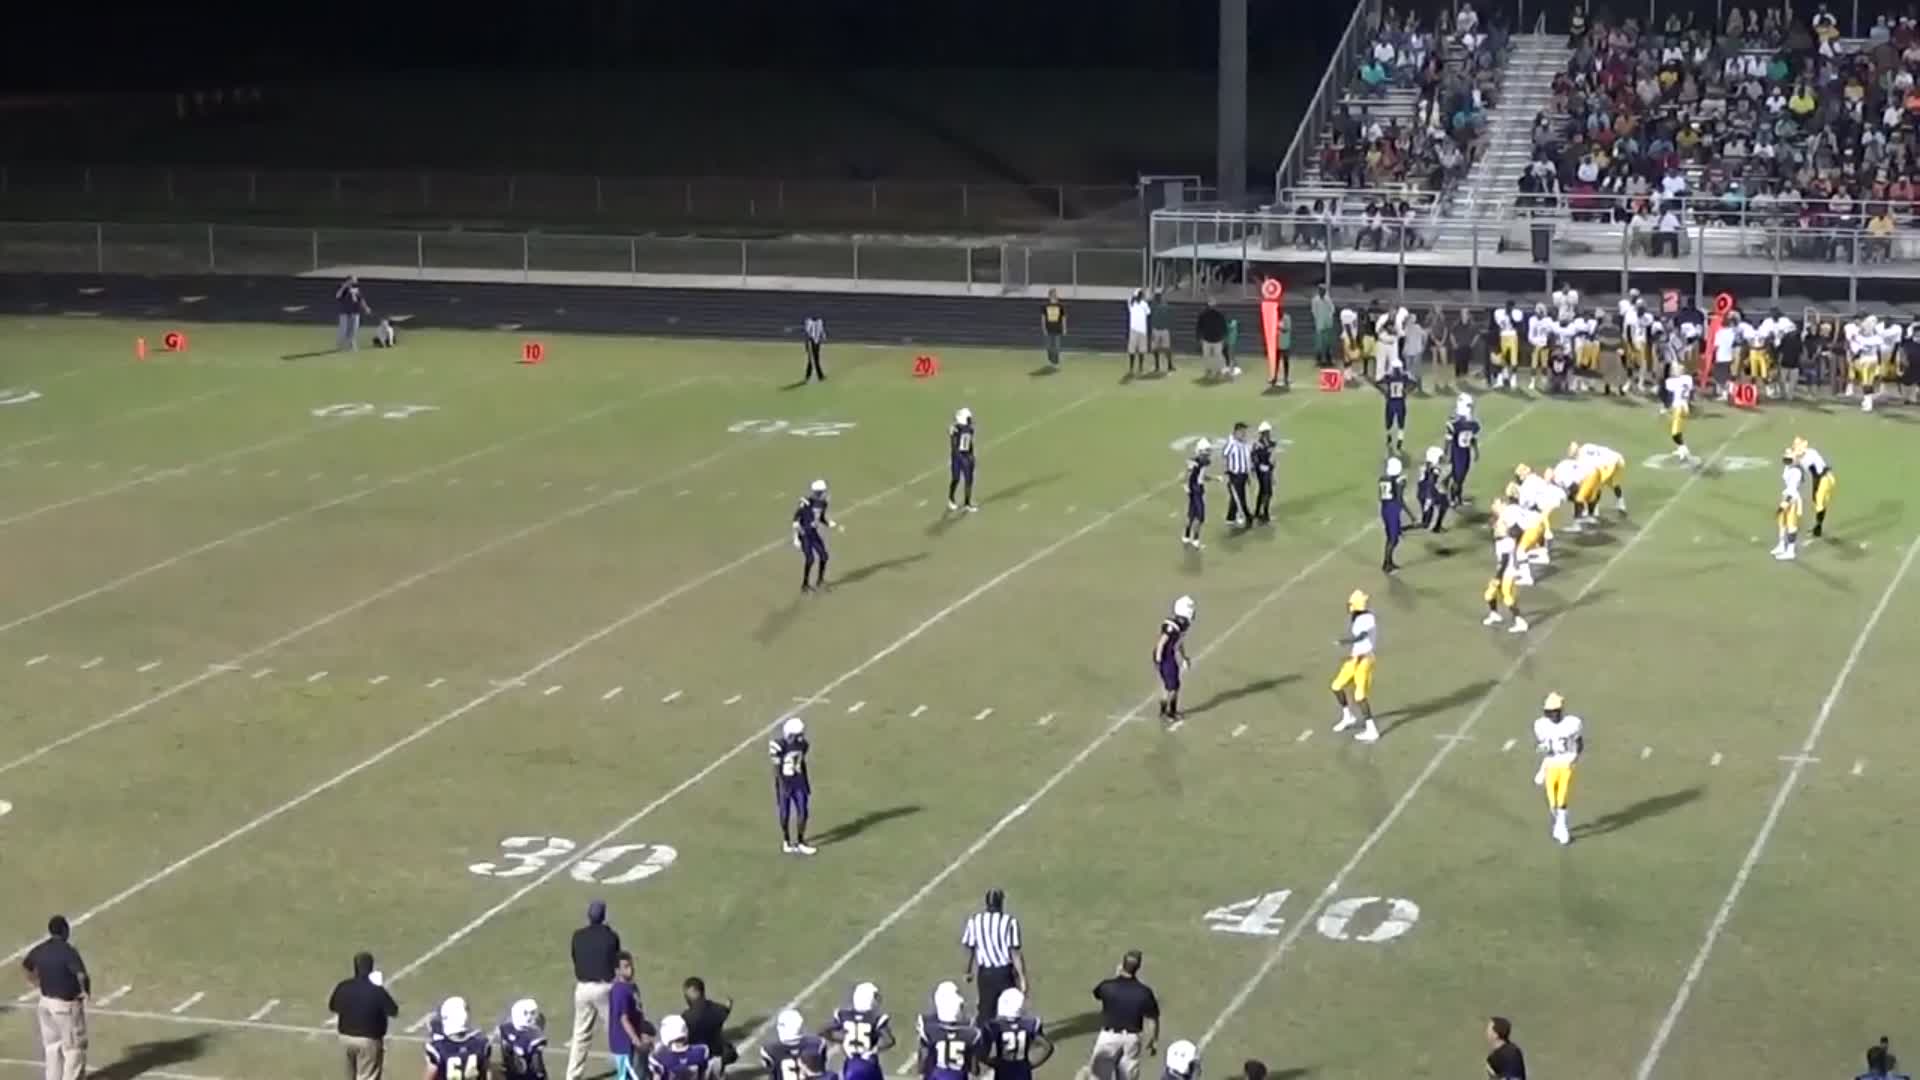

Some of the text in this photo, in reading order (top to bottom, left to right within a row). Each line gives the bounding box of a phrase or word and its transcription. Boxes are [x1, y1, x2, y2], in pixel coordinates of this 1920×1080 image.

[525, 343, 541, 360] 10
[468, 836, 678, 884] 30
[1203, 889, 1420, 942] 40
[935, 1040, 965, 1070] 15
